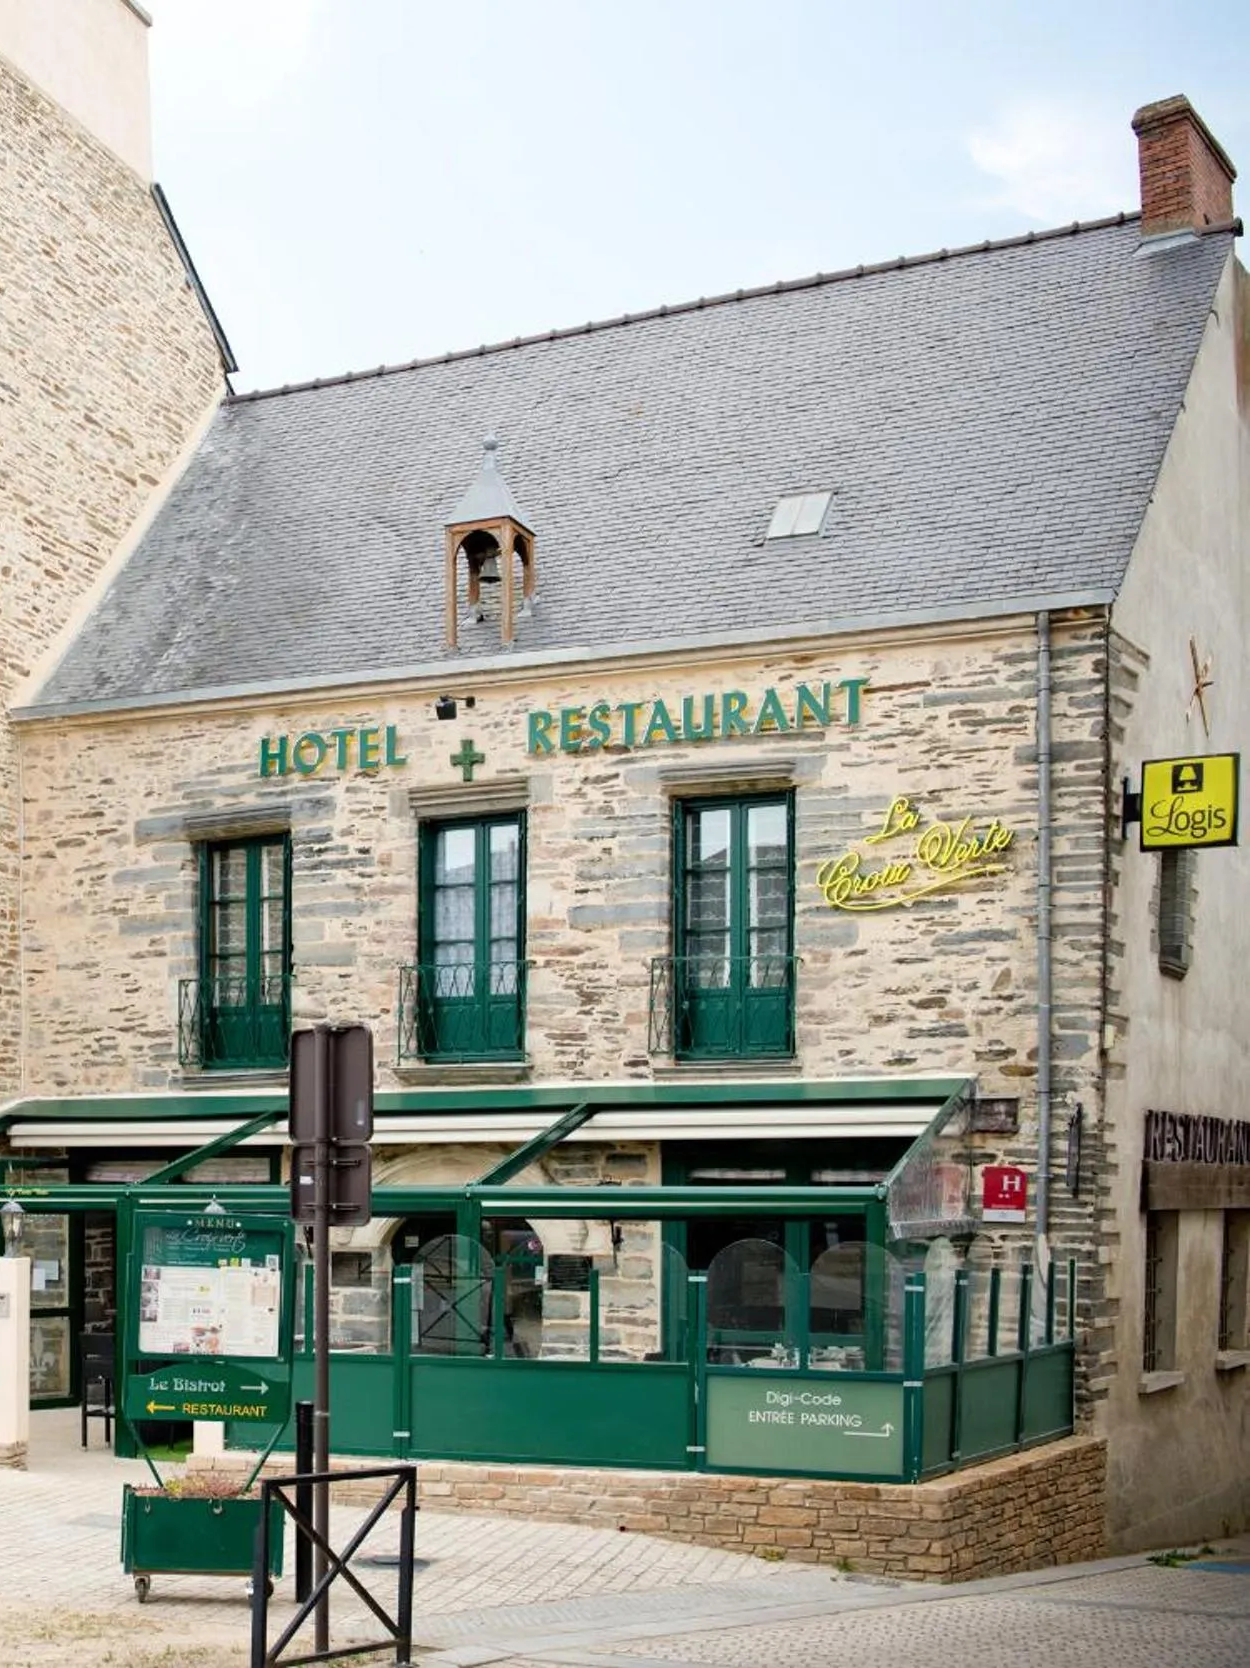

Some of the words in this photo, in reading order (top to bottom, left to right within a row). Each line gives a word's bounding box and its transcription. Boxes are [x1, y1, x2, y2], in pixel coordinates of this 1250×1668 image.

[527, 677, 871, 755] RESTAURANT
[259, 723, 408, 778] HOTEL
[862, 796, 920, 844] La
[1146, 795, 1227, 839] Logis
[916, 813, 1014, 872] Verte
[1002, 1175, 1022, 1192] H
[193, 1217, 235, 1229] MENU
[149, 1378, 169, 1391] Le
[173, 1378, 226, 1392] Bistrot
[766, 1390, 842, 1407] Digi-Code
[182, 1403, 267, 1417] RESTAURANT
[749, 1410, 795, 1425] ENTRÉE
[800, 1413, 863, 1428] PARKING
